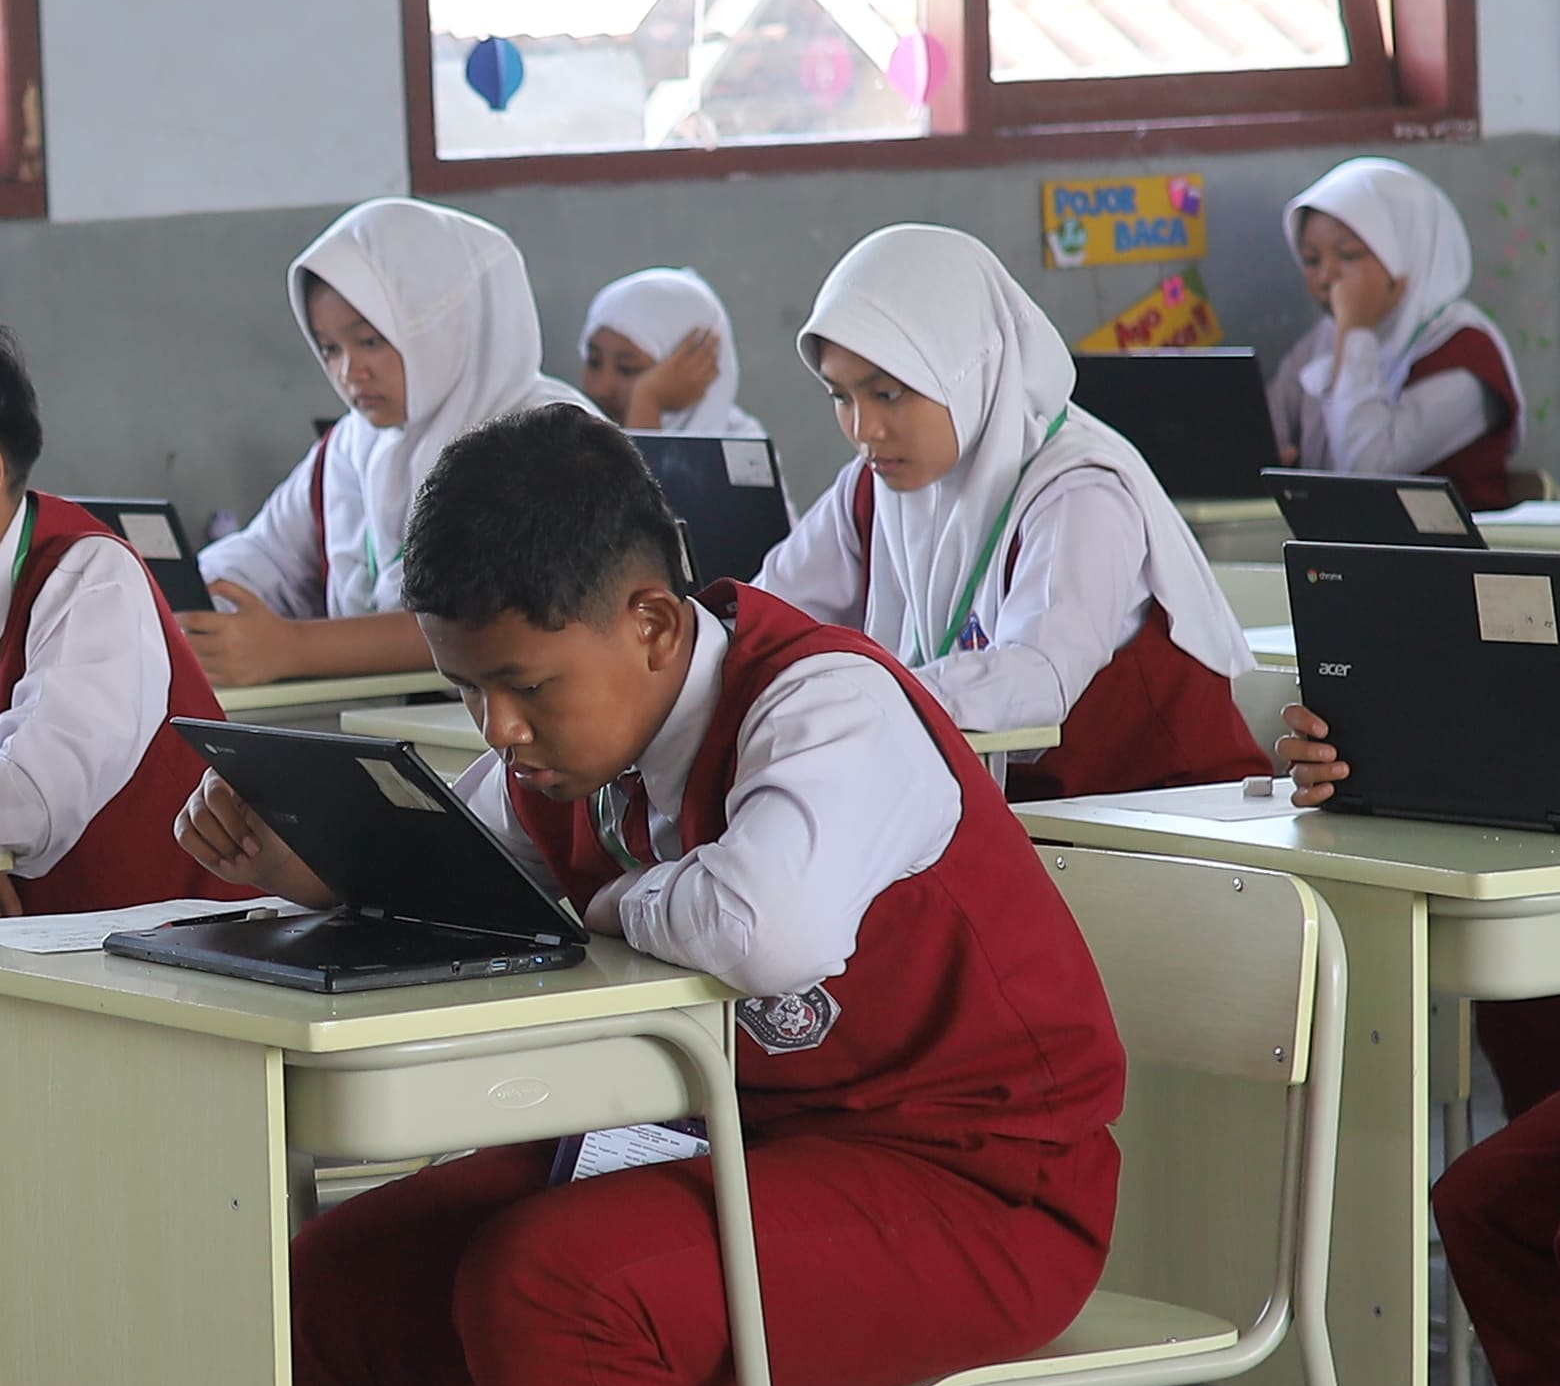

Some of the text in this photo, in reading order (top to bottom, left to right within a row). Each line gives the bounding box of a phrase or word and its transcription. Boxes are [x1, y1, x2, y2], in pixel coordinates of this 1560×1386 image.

[1055, 185, 1136, 217] POJOK
[1114, 217, 1188, 253] BACA
[1319, 662, 1351, 677] acer
